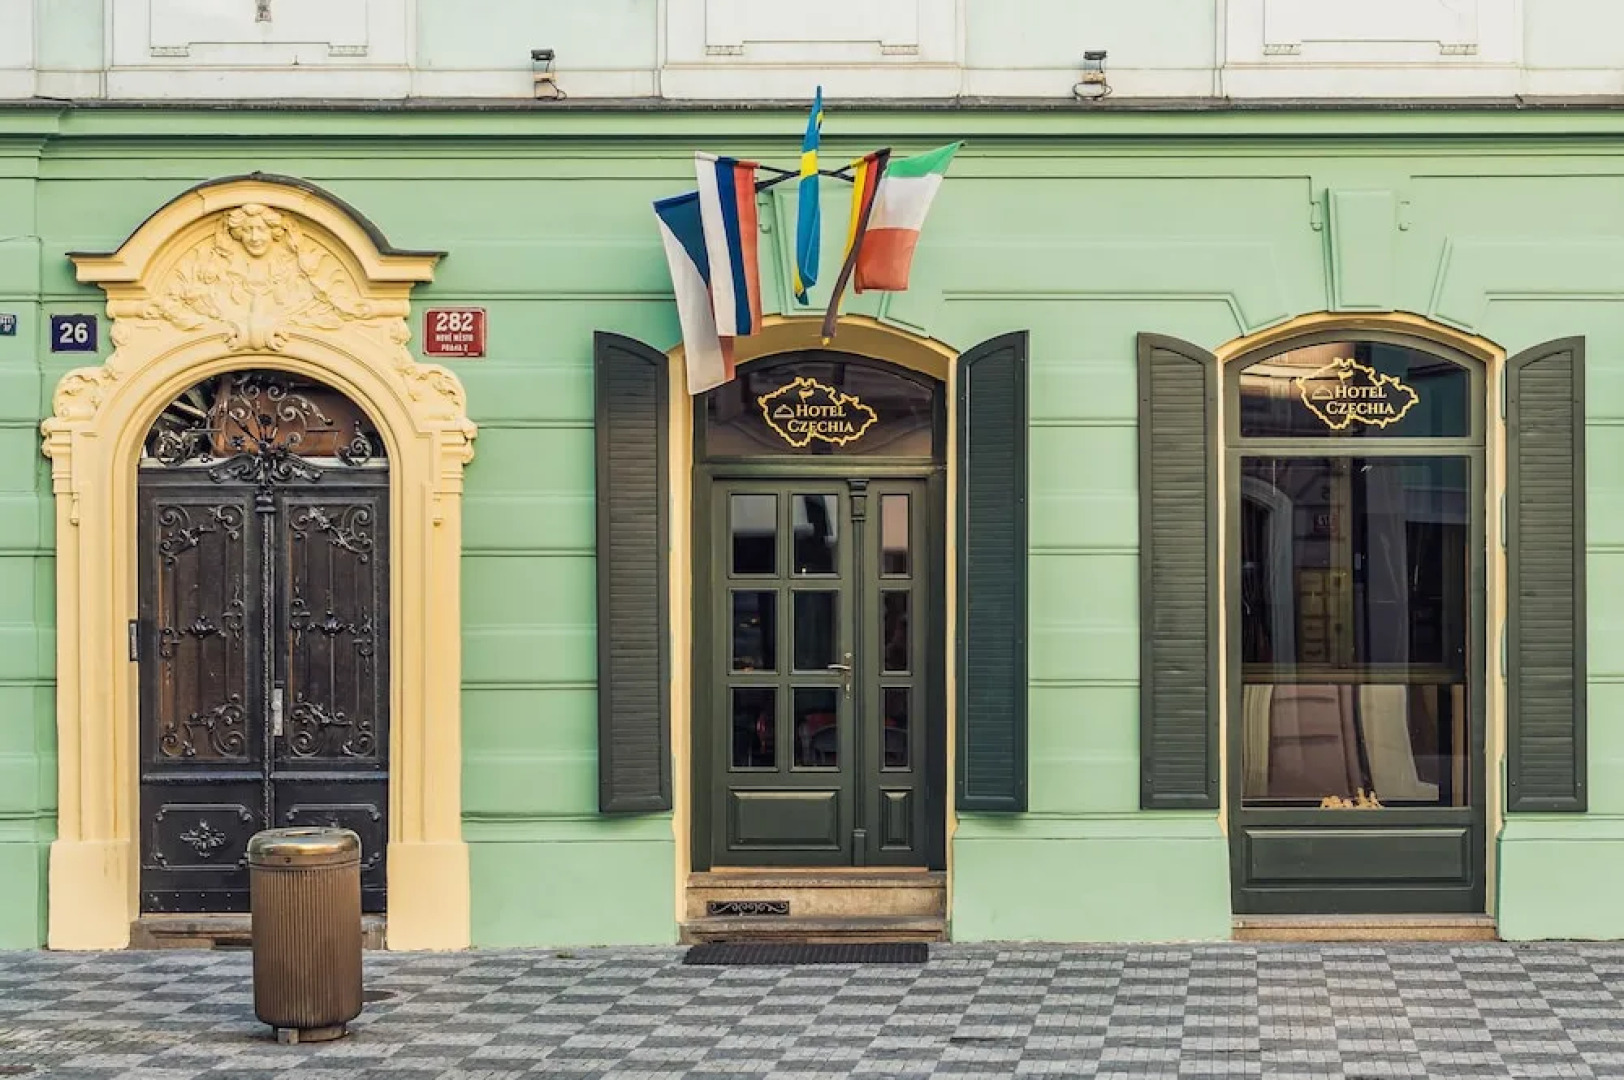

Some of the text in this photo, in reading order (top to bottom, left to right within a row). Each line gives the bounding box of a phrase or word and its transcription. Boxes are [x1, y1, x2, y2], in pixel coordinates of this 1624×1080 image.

[435, 312, 474, 332] 282
[60, 322, 89, 344] 26
[1335, 384, 1388, 399] HOTEL
[795, 403, 847, 417] HOTEL
[1326, 401, 1396, 415] CZECHIA
[787, 419, 855, 433] CZECHIA
